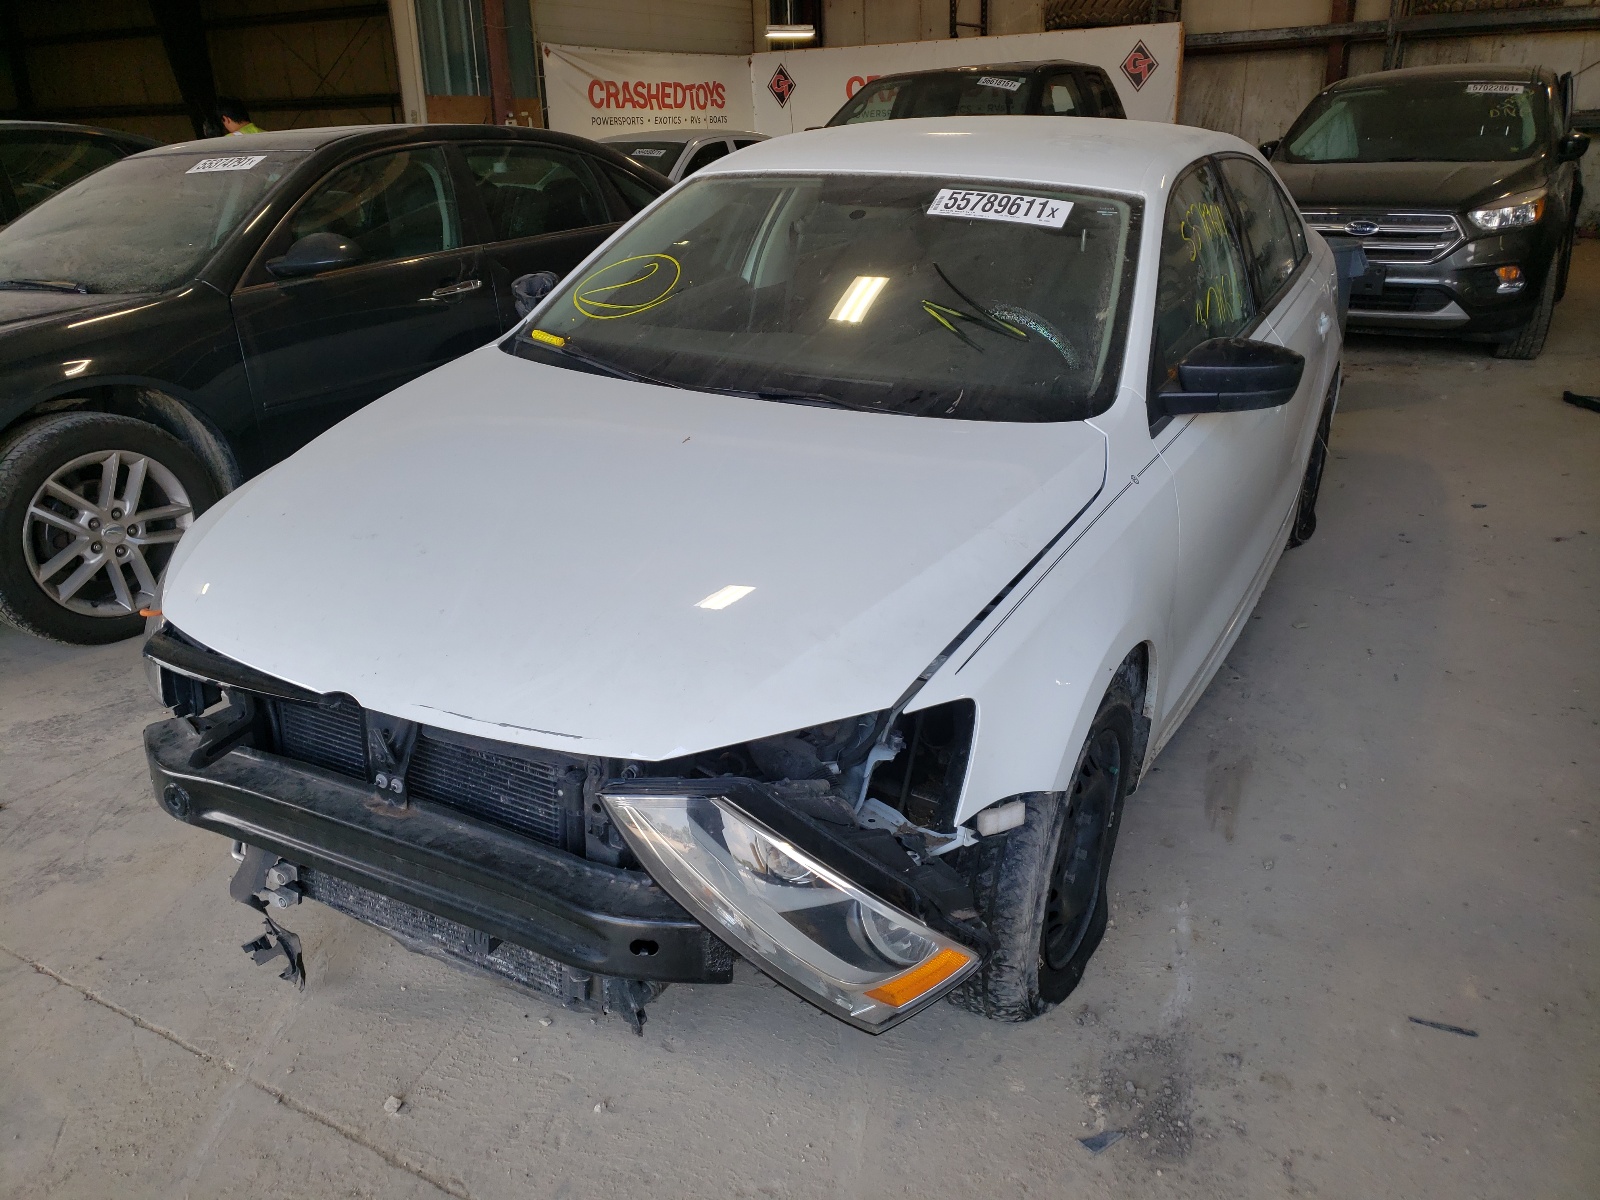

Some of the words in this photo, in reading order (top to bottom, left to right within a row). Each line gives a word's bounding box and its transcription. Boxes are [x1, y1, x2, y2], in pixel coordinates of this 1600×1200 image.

[588, 79, 726, 110] CRASHEDTOYS
[591, 116, 644, 126] POWERSPORTS
[654, 116, 682, 125] EXOTICS
[690, 116, 701, 124] RVs
[709, 115, 728, 124] BOATS
